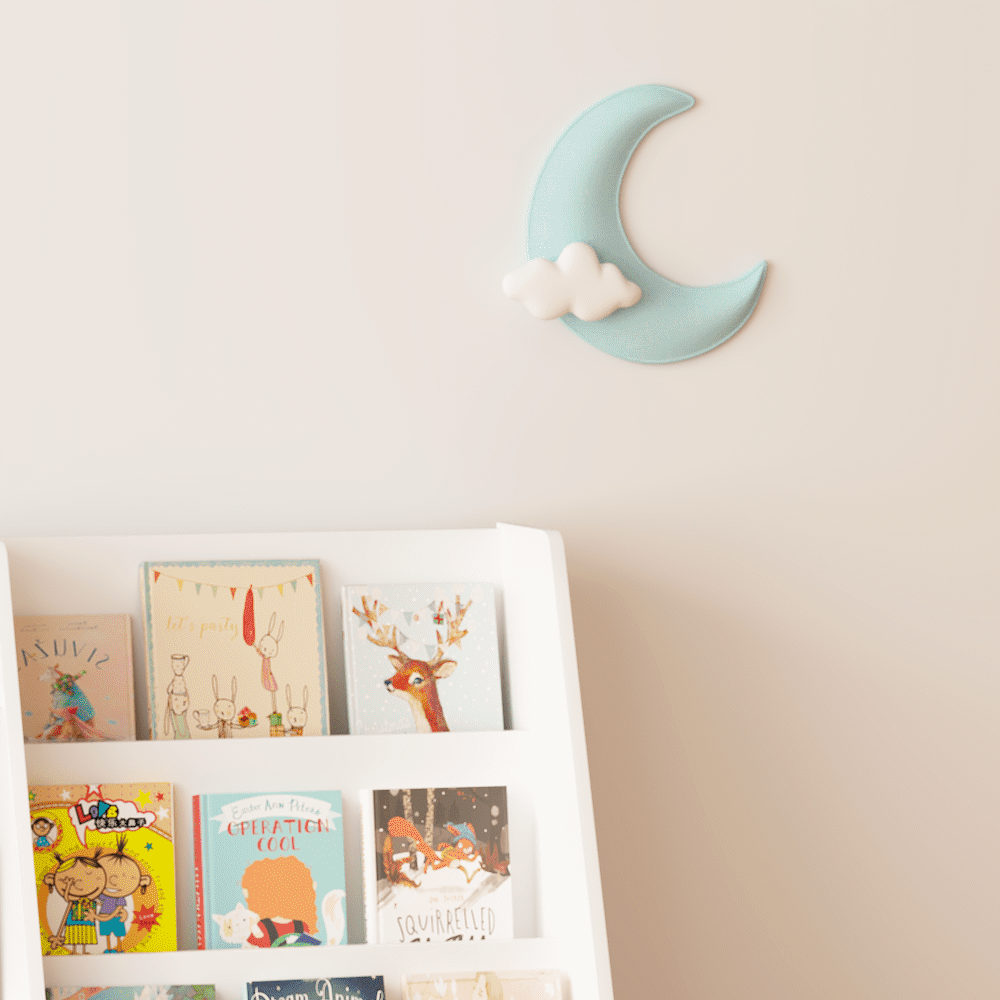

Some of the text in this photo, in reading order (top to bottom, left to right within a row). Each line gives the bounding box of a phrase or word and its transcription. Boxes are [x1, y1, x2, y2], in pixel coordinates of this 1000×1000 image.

[227, 819, 329, 836] OPERATION
[257, 836, 300, 852] COOL
[397, 907, 495, 943] SQUIRRELLED
